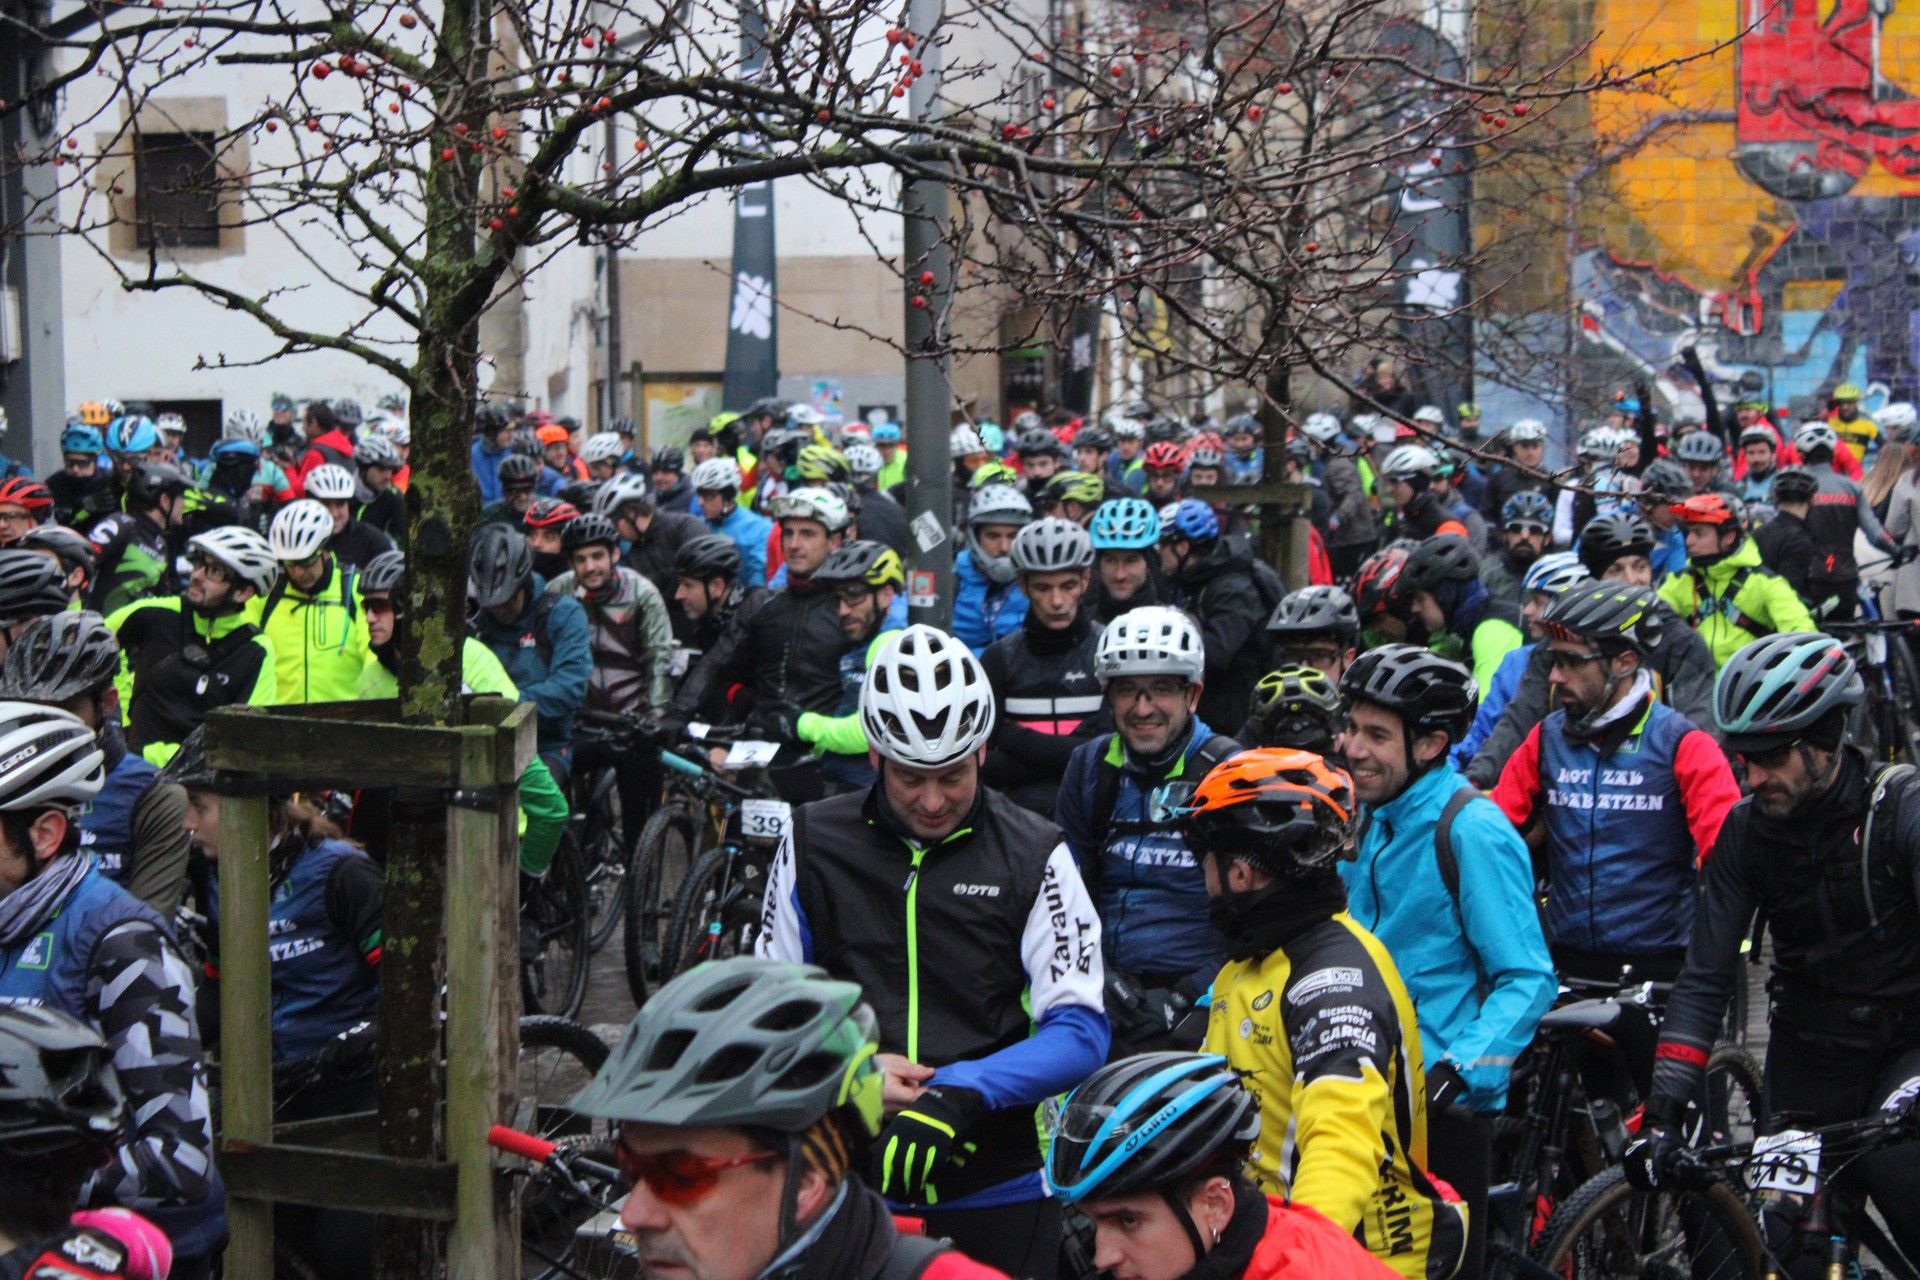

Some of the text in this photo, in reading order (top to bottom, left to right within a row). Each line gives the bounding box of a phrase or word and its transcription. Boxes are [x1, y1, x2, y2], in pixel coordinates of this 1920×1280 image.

[744, 750, 757, 761] 2
[752, 815, 782, 835] 39
[1330, 1014, 1365, 1027] MOTOS
[1319, 1024, 1377, 1046] GARCÍA
[1140, 1104, 1178, 1138] GIRO
